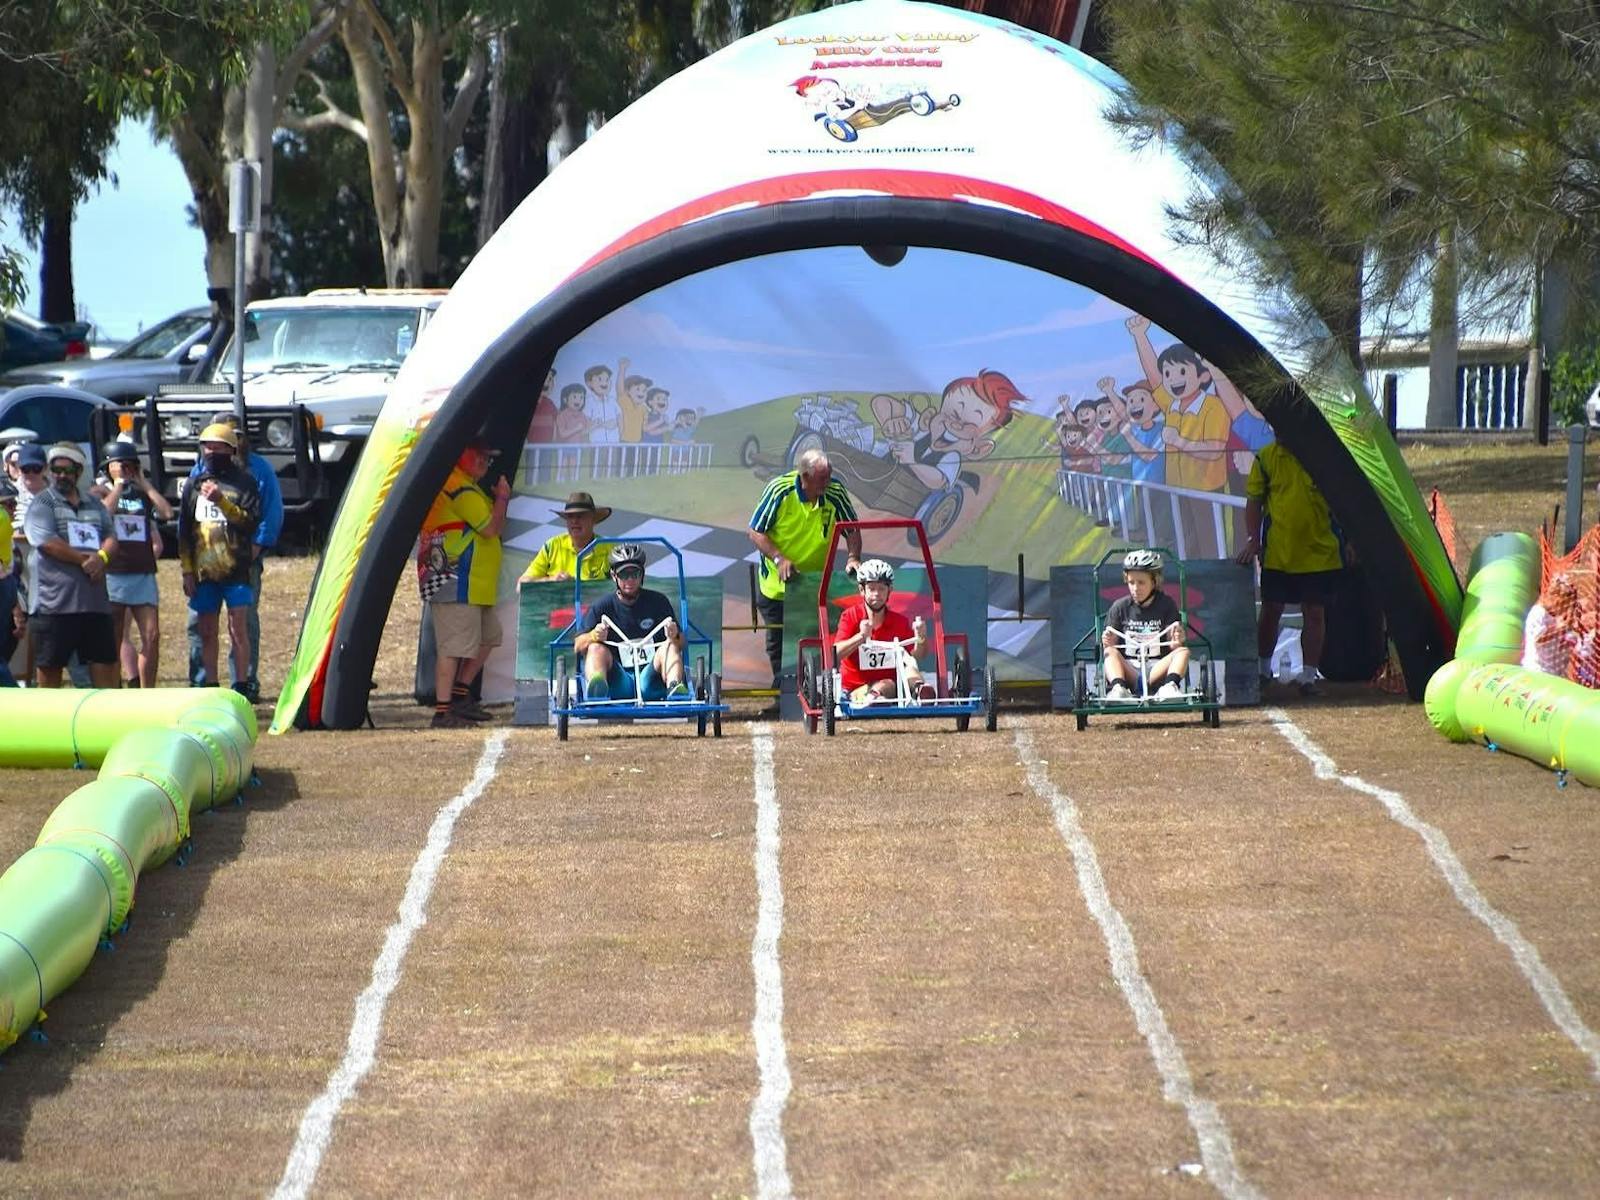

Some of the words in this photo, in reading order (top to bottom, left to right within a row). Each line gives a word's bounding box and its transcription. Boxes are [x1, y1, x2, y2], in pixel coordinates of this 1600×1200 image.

[814, 45, 877, 56] Billy
[204, 504, 219, 518] 15
[869, 652, 886, 667] 37
